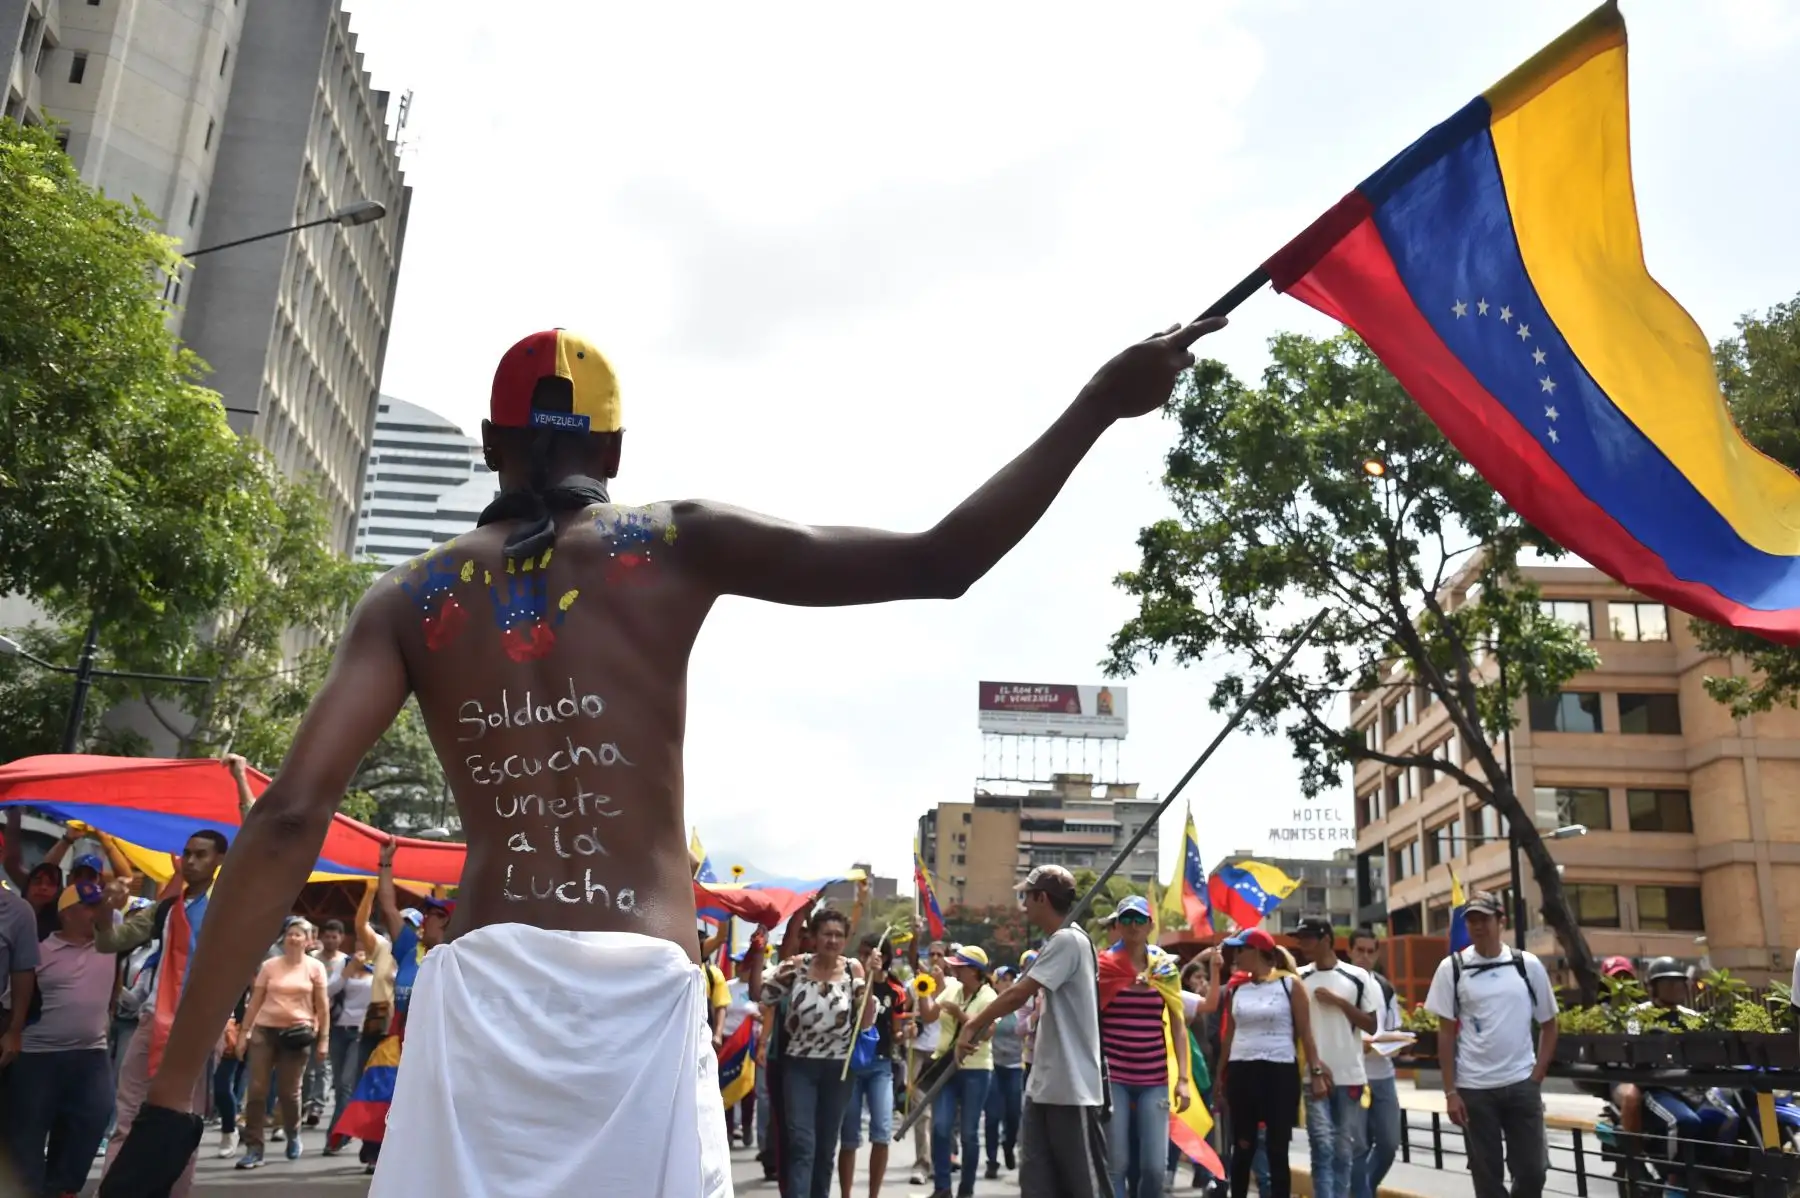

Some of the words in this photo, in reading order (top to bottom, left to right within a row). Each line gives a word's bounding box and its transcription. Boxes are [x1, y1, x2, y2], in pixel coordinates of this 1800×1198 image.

[534, 413, 584, 427] VENEZUELA
[457, 678, 606, 742] Soldado
[465, 736, 637, 784] Escucha
[1293, 808, 1343, 822] HOTEL
[507, 831, 537, 853] a
[554, 826, 610, 858] la
